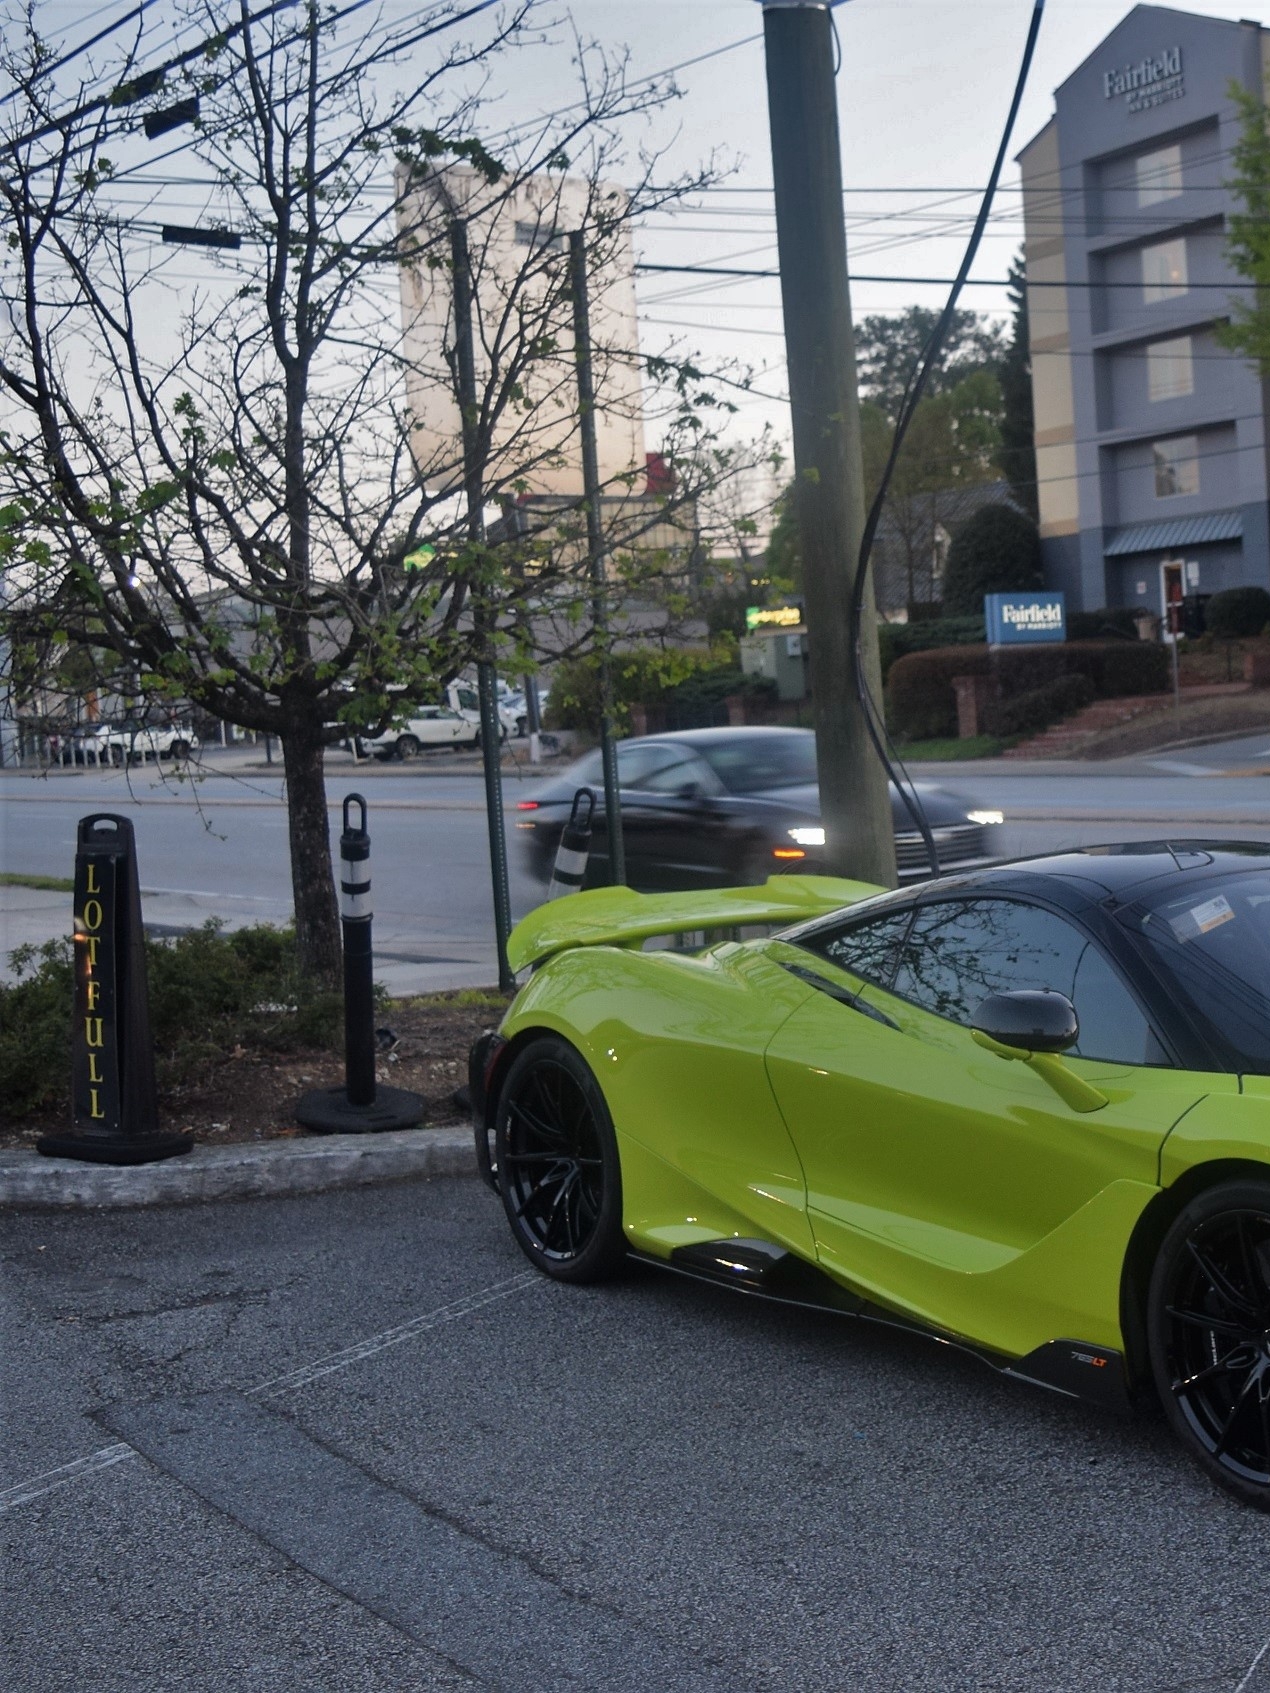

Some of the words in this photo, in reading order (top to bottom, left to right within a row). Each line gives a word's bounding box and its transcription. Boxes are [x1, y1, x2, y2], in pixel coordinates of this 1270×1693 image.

[1104, 47, 1181, 99] Fairfield
[1002, 603, 1061, 623] Fairfield
[1016, 623, 1026, 631] BY
[83, 864, 102, 966] LOT
[85, 981, 105, 1119] FULL
